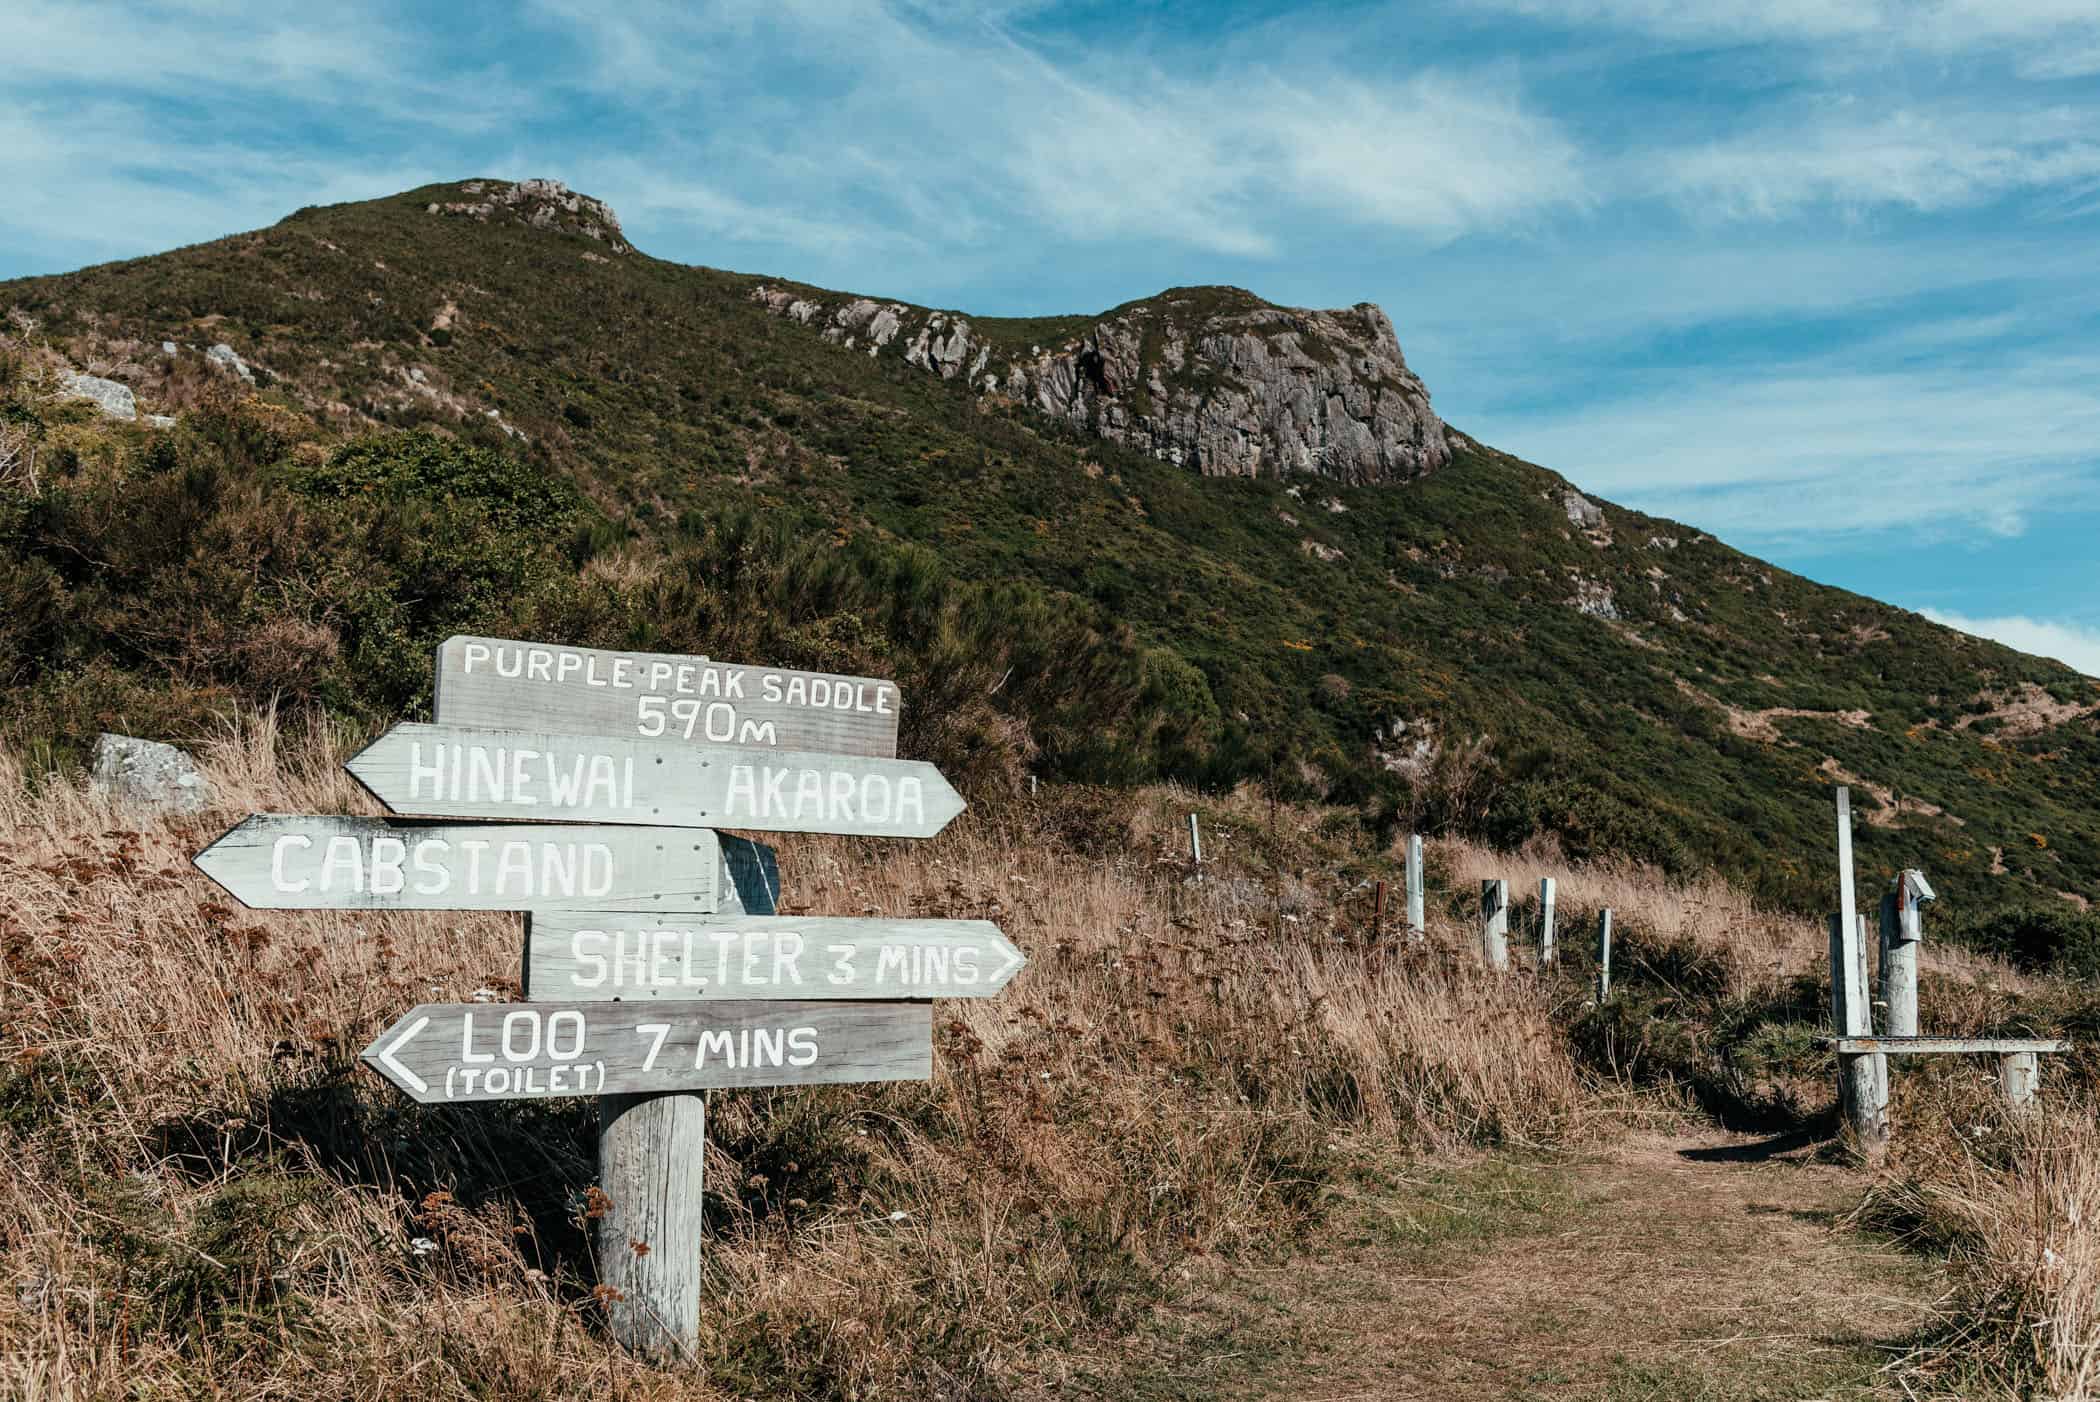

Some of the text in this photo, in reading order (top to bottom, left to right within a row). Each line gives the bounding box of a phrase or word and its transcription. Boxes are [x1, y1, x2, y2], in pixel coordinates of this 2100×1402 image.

[463, 642, 893, 714] PURPLE PEAK SADDLE
[409, 742, 634, 809] HINEWAI
[724, 764, 924, 825] AKAROA
[271, 834, 613, 896] CABSTAND
[570, 930, 981, 987] SHELTER 3 MINS
[461, 1011, 819, 1072] LOO 7 MINS
[444, 1061, 606, 1098] (TOILET)
